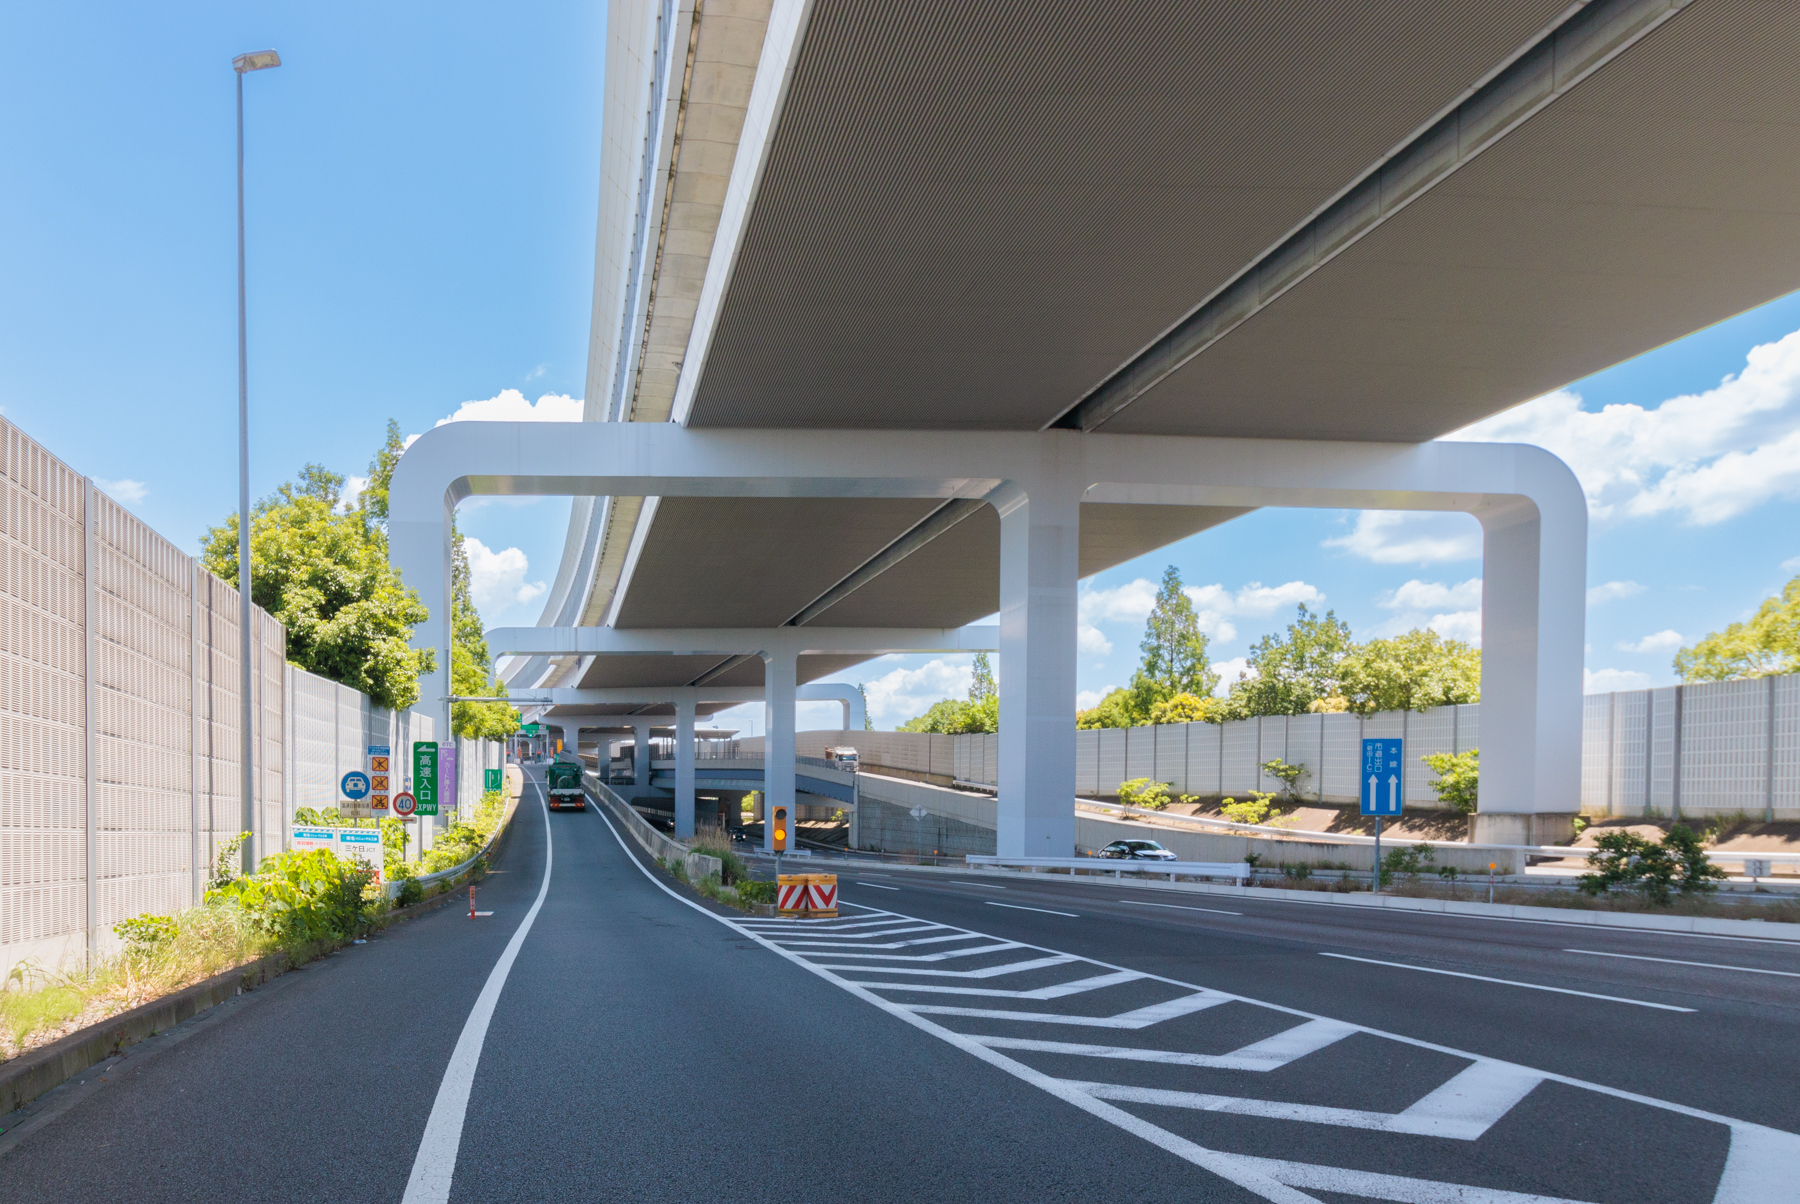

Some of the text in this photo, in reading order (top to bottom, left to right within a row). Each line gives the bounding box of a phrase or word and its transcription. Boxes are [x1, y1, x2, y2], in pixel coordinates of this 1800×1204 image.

[420, 755, 431, 800] 高速入口
[398, 798, 412, 810] 40
